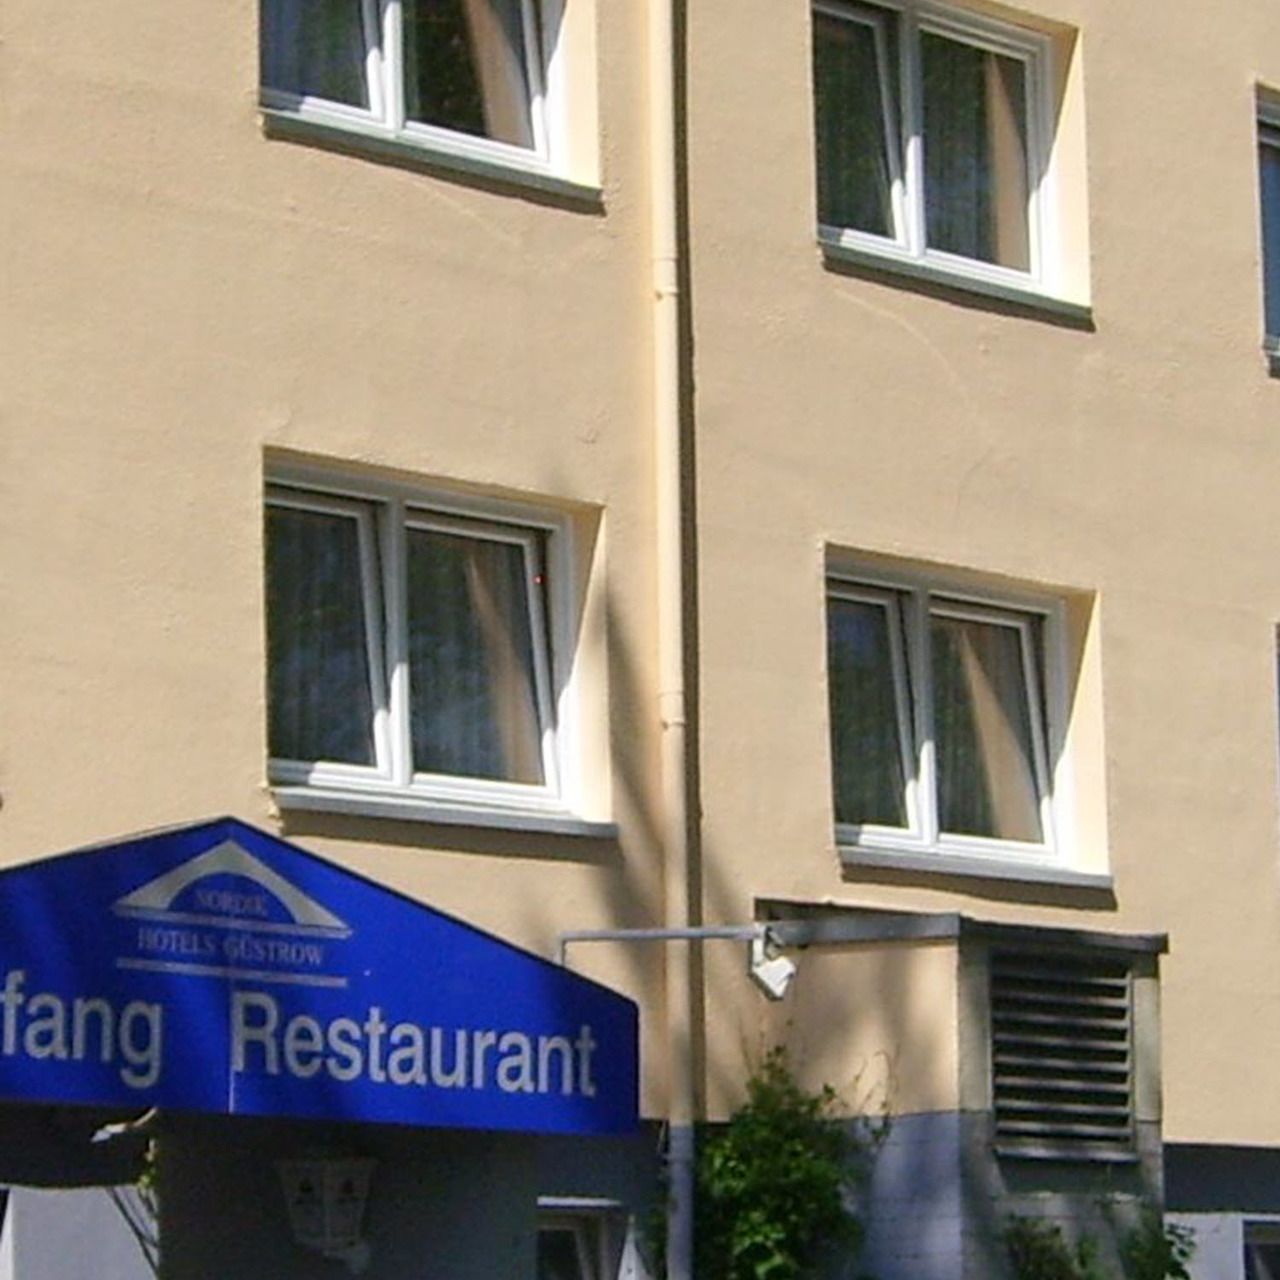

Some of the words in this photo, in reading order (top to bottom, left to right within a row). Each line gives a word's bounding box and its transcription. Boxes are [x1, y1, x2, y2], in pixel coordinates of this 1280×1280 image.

[138, 927, 216, 954] HOTELS
[222, 934, 324, 966] GÜSTROW
[232, 990, 597, 1098] Restaurant
